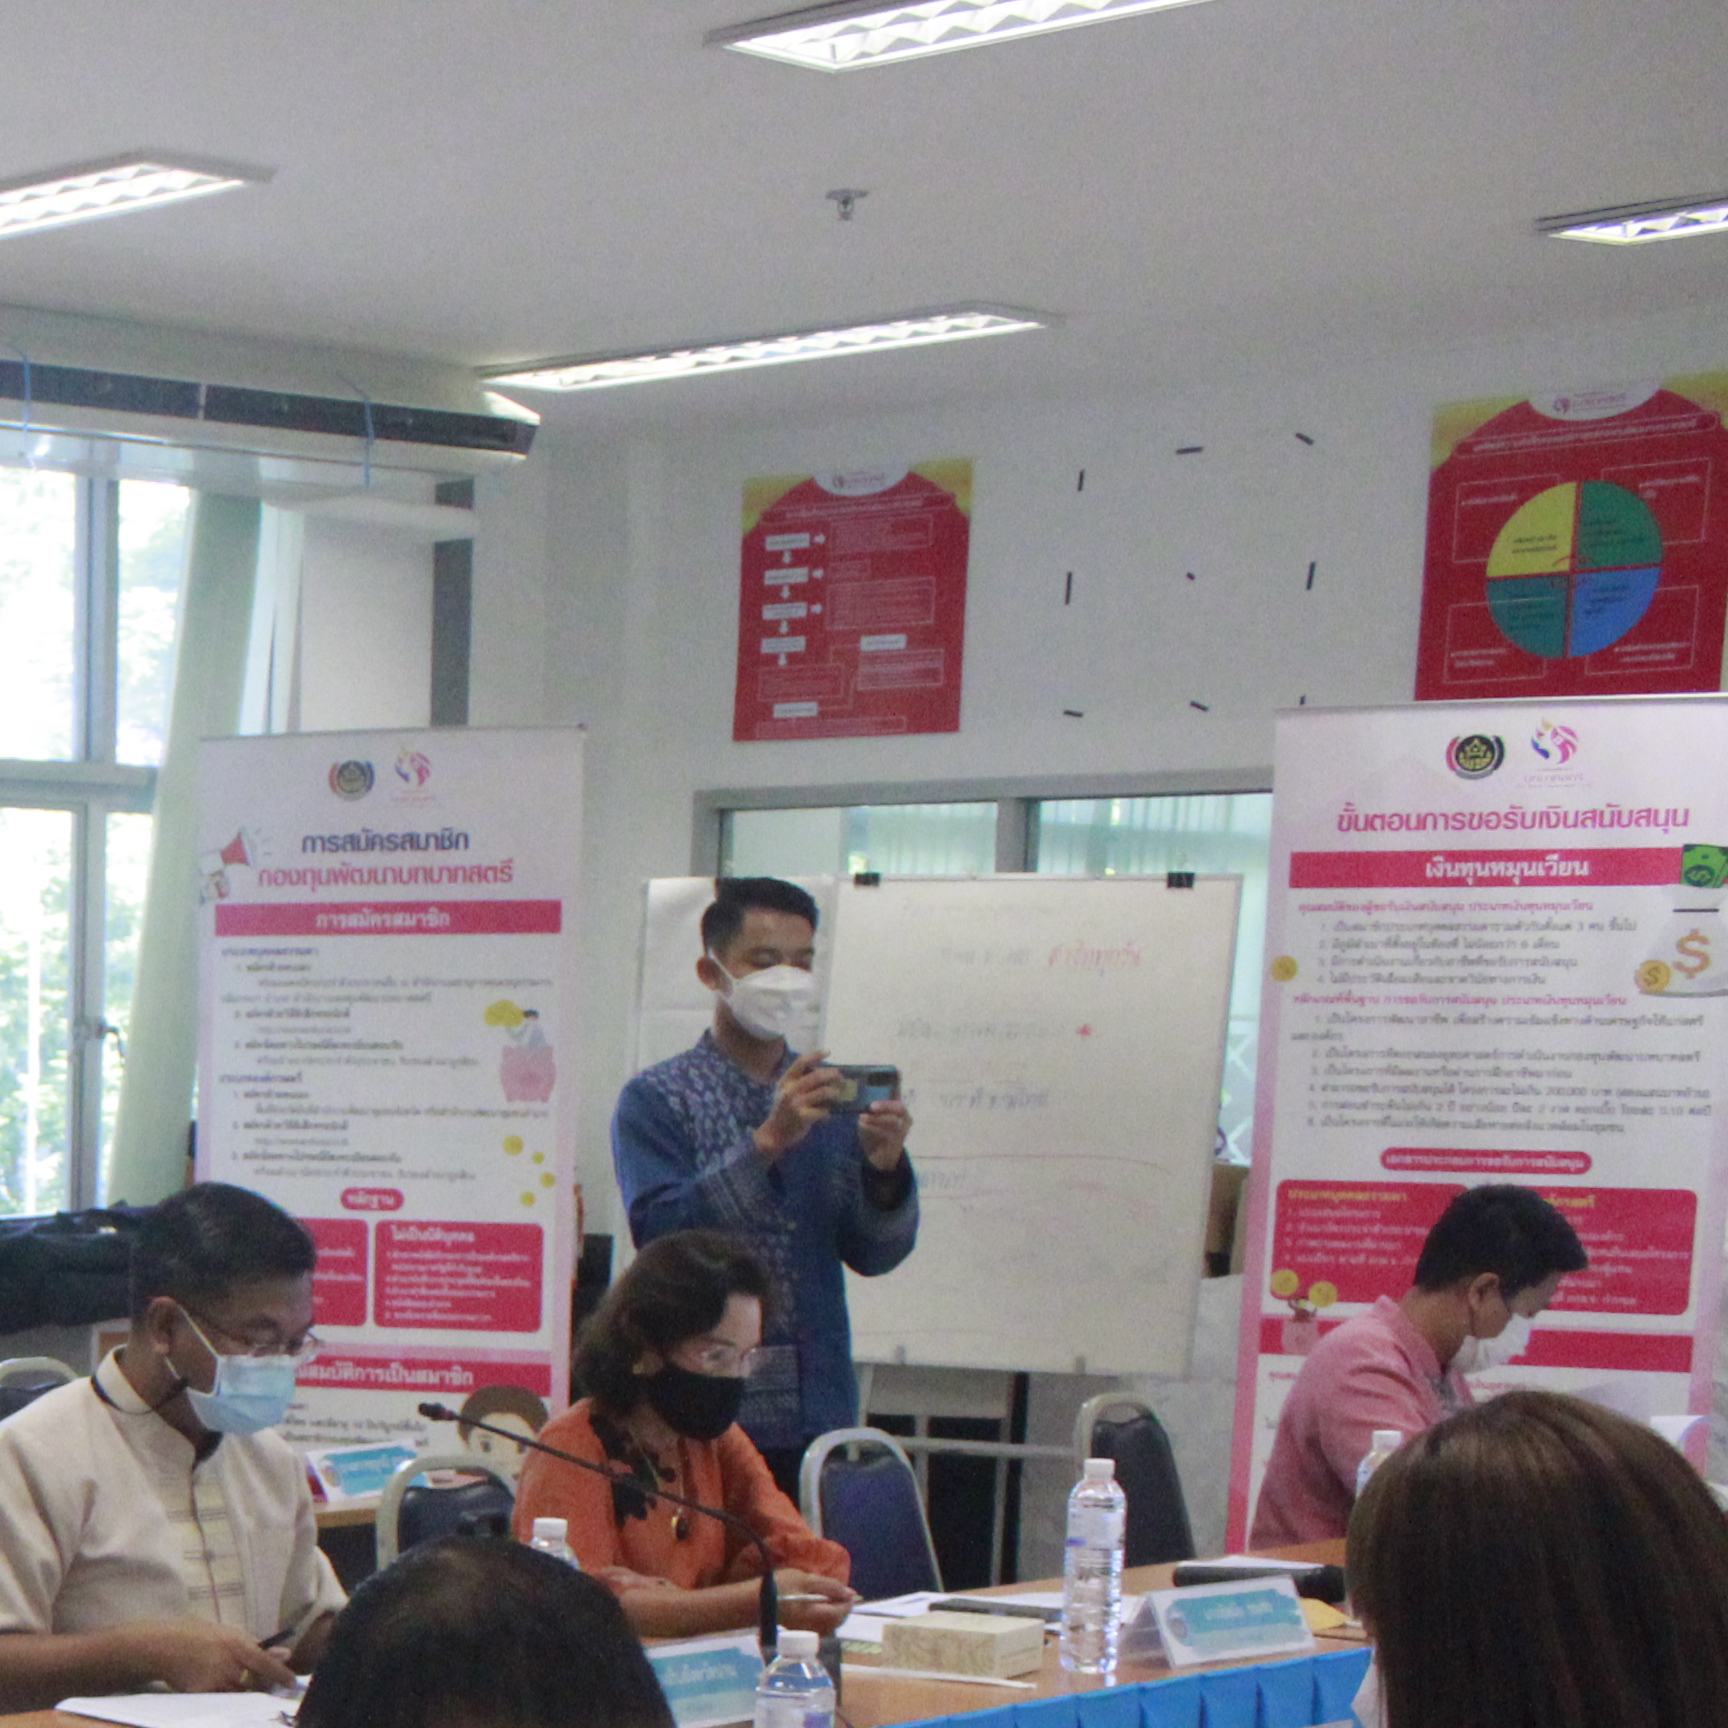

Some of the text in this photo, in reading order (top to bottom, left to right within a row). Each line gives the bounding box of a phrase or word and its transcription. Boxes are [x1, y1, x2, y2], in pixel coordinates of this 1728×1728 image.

[1336, 802, 1690, 834] ขั้นตอนการขอรับเงินสนับสนุน
[301, 826, 470, 855] การสมัครสมาชิก
[258, 858, 514, 892] กองทุนพัฒนาบทบาทสตรี
[1425, 853, 1589, 885] เงินทุนหมุนเวียน
[316, 908, 450, 929] การสมัครสมาชิก
